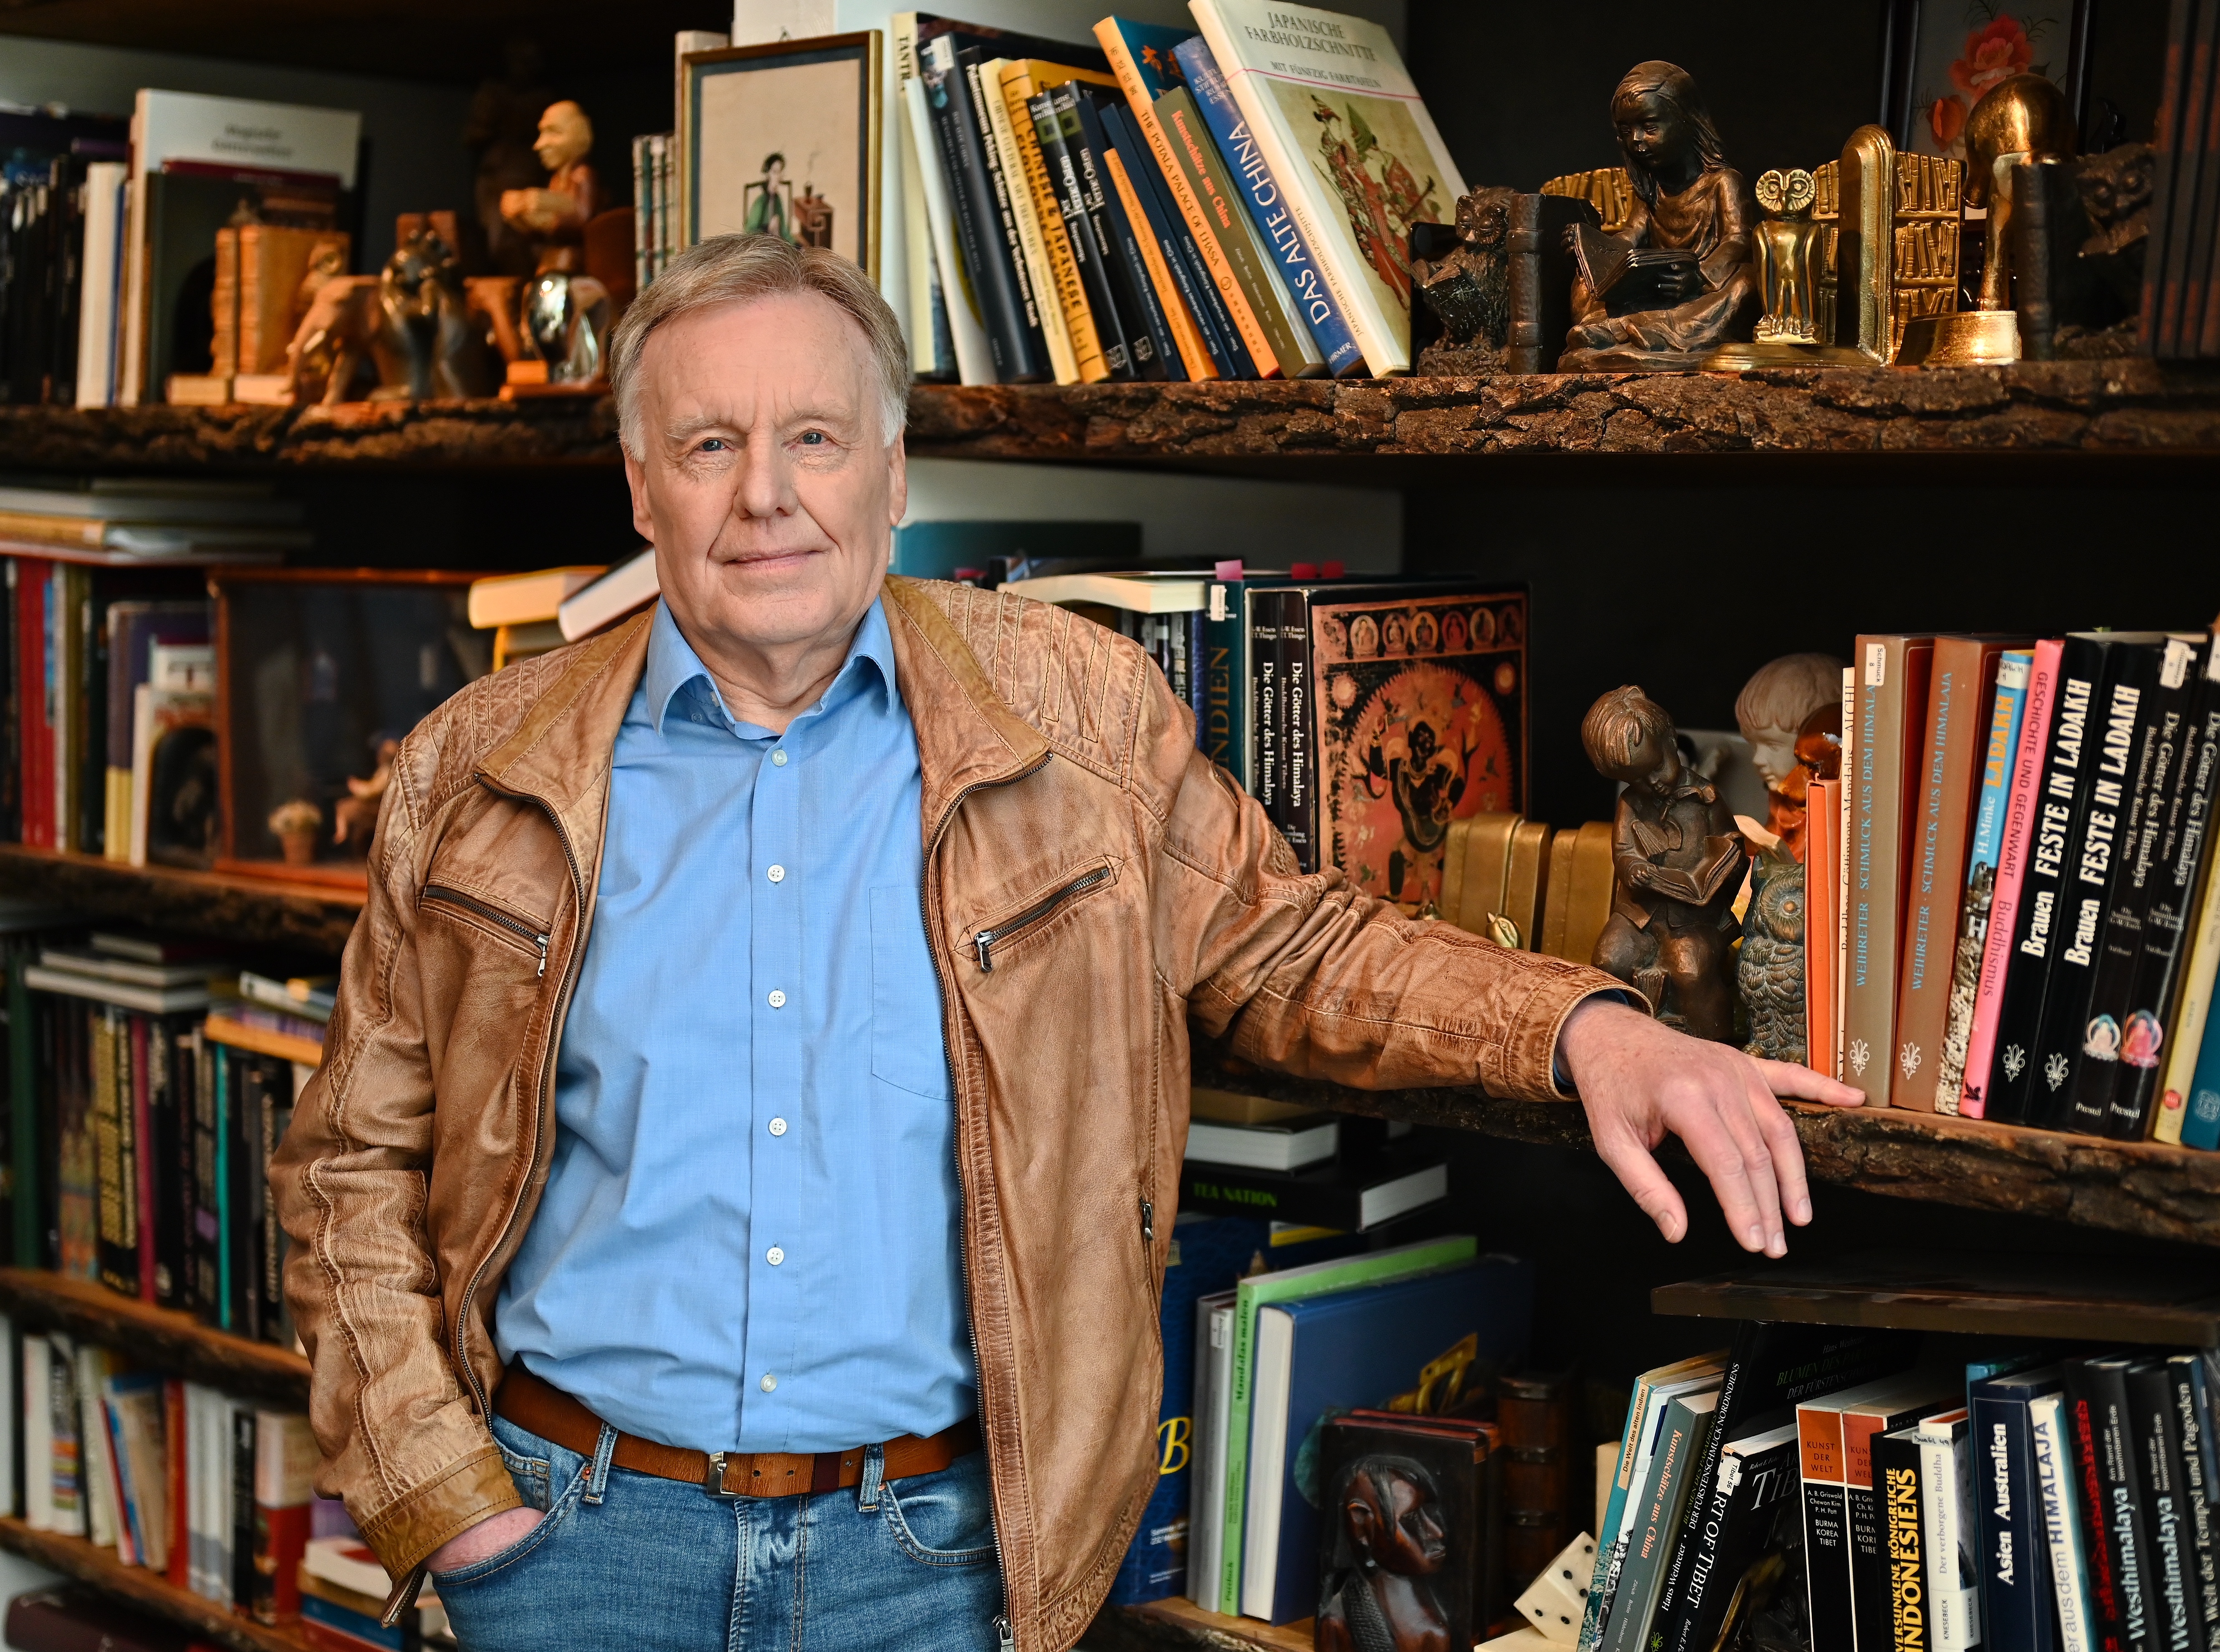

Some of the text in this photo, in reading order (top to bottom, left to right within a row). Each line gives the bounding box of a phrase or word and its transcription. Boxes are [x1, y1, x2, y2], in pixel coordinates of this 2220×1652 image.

[899, 36, 910, 91] TANTR
[1268, 12, 1345, 38] JAPANISCHE
[1271, 61, 1287, 72] MIT
[1290, 63, 1328, 80] FÜNFZIG
[1141, 110, 1220, 266] THE POTALA PALACE OF LHASA
[1171, 110, 1231, 229] Kunstschätze aus China
[1051, 227, 1082, 308] JAPANESE
[1228, 121, 1331, 325] DAS ALTE CHINA
[1328, 341, 1352, 365] HIRMER
[1336, 288, 1364, 336] JAPANISCHE
[1210, 646, 1229, 763] NDIEN
[1262, 662, 1276, 806] Die Götter des Himalaya
[1291, 662, 1305, 807] Die Götter des Himalaya
[1985, 695, 2015, 788] LADAKH
[1912, 672, 1952, 990] WEIHRETER SCHMUCK AUS DEM HIMALAJA
[1984, 672, 2048, 997] Buddhismus GESCHICHTE UND GEGENWART
[2020, 677, 2092, 958] Brauen FESTE IN LADAKH
[2064, 683, 2141, 967] Brauen FESTE IN LADAKH
[2131, 712, 2180, 888] Die Götter des Himalaya
[2172, 743, 2217, 887] Götter des Himalaya
[1856, 748, 1874, 986] WEIHRETER SCHMUCK AUS DEM
[2076, 1102, 2102, 1116] Prestel
[2110, 1101, 2140, 1119] Prestel
[1236, 1341, 1247, 1399] Mandalas
[1637, 1389, 1646, 1410] Indien
[1776, 1363, 1818, 1386] BLUMEN
[1787, 1384, 1804, 1399] DER
[1683, 1414, 1717, 1525] BLUMEN DES PARADIESES
[1689, 1363, 1740, 1530] DER FÜRSTENSCHMUCK NORDINDIENS
[1727, 1464, 1737, 1490] Tibet 56
[1807, 1441, 1835, 1450] KUNST
[1811, 1464, 1833, 1473] WELT
[2109, 1404, 2125, 1481] bewohnbaren Erde
[2154, 1412, 2169, 1490] bewohnbaren Erde
[1641, 1428, 1683, 1559] Kunstschätze aus China
[1815, 1519, 1838, 1528] BURMA
[1816, 1528, 1838, 1538] KOREA
[1933, 1454, 1947, 1574] Der verborgene Buddha
[1990, 1423, 2014, 1586] Asien Australien
[2034, 1422, 2077, 1633] aus dem HIMALAJA
[2177, 1382, 2219, 1622] Welt der Tempel und Pagoden
[1661, 1543, 1686, 1611] Hans Weihreter
[1686, 1521, 1719, 1609] OF TIBET
[1820, 1538, 1836, 1547] TIBET
[1886, 1468, 1904, 1652] VERSUNKENE KÖNIGREICHE
[1896, 1468, 1924, 1652] INDONESIENS
[2113, 1487, 2146, 1640] Westhimalaya
[2157, 1497, 2190, 1652] Westhimalaya
[1618, 1617, 1628, 1644] Hildesheim
[1682, 1618, 1691, 1637] Robert
